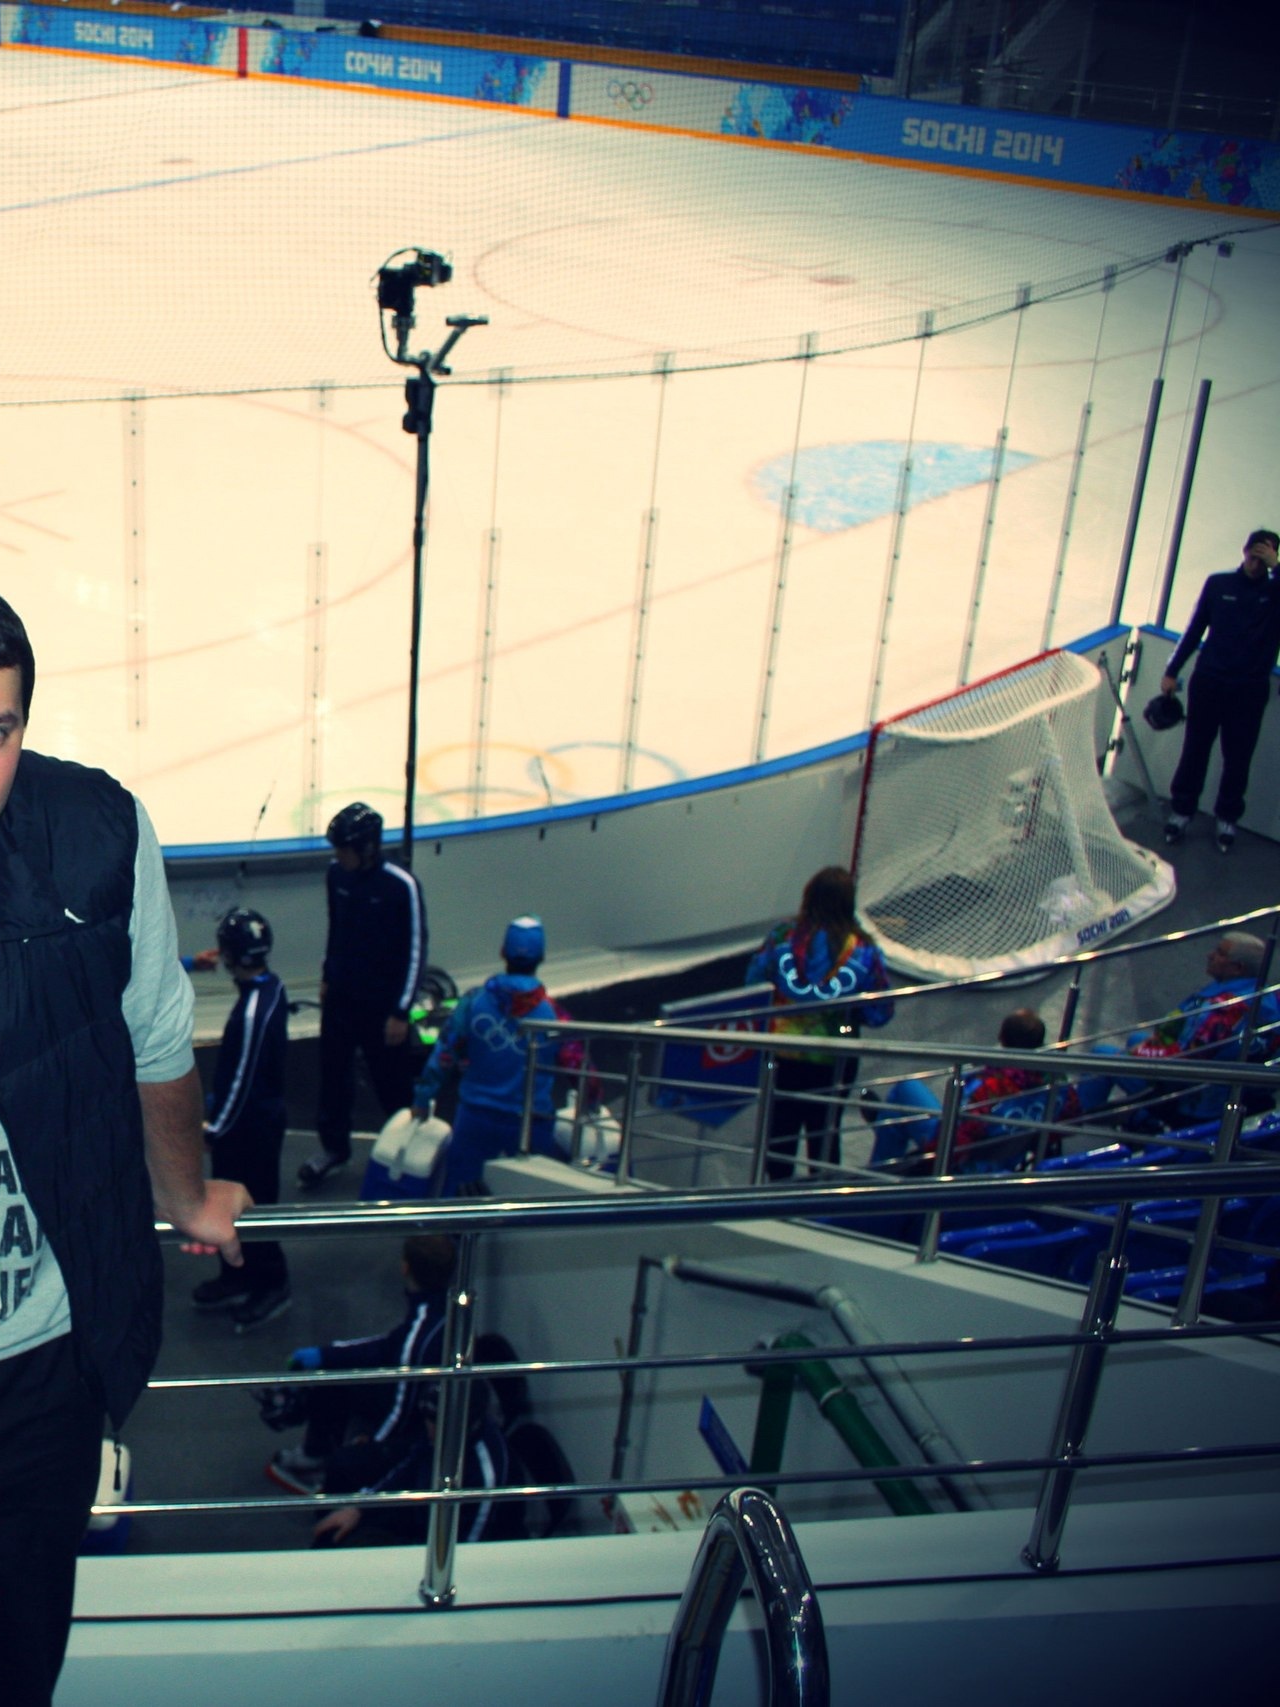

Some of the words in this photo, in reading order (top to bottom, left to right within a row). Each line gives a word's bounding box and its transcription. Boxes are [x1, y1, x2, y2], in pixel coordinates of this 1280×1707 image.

[74, 21, 116, 45] SOCHI
[118, 26, 153, 50] 2014
[345, 51, 393, 78] СОЧИ
[398, 56, 442, 84] 2014
[901, 117, 987, 155] SOCHI
[992, 128, 1065, 166] 2014
[1076, 918, 1108, 946] SOCHI
